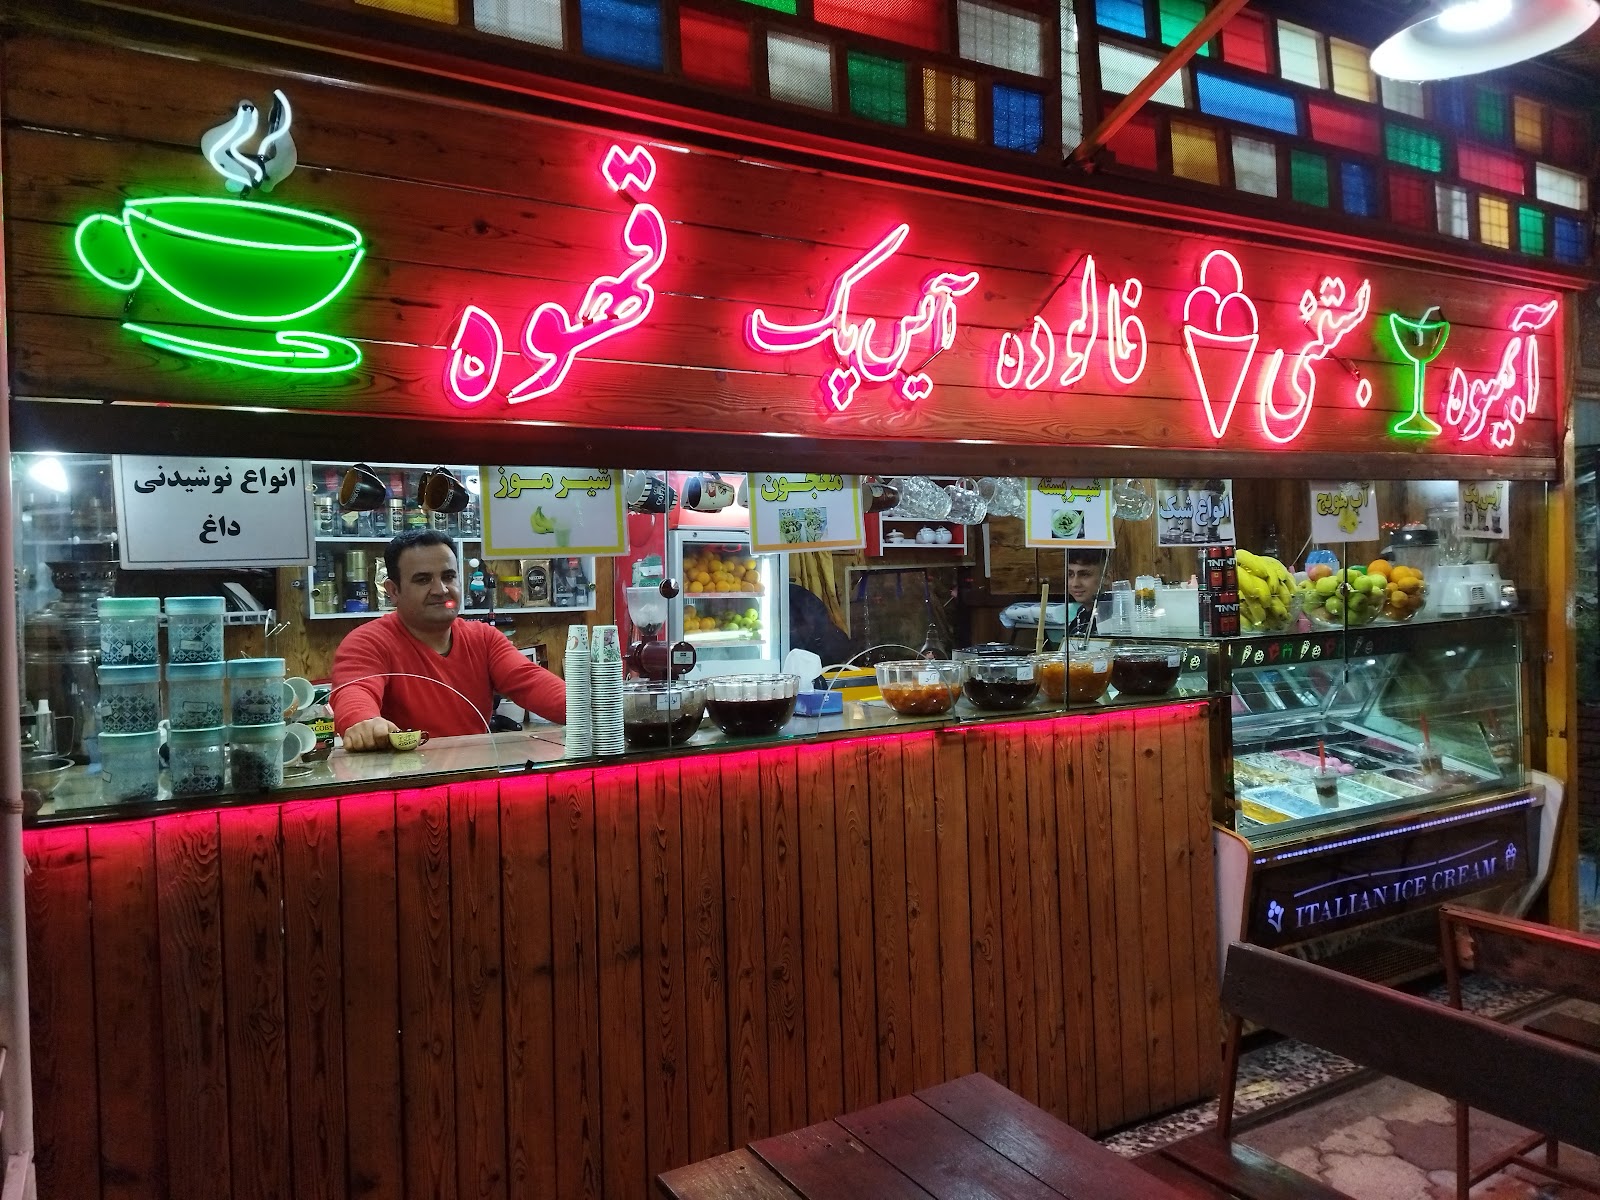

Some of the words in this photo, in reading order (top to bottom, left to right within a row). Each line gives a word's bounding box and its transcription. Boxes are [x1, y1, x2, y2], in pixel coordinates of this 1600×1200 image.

[449, 144, 668, 405] قهوه
[996, 254, 1148, 390] فالوده
[1260, 276, 1373, 443] بستنی
[1446, 300, 1558, 449] آبمیوه
[134, 465, 233, 494] نوشیدنی
[240, 466, 296, 494] انواع
[494, 466, 553, 498] موز
[555, 466, 612, 498] شیر
[761, 473, 844, 501] معجون
[1159, 495, 1194, 525] شیک
[1195, 494, 1230, 526] انواع
[1317, 491, 1349, 515] هویج
[1350, 483, 1370, 515] آب
[199, 514, 241, 543] داغ
[1207, 559, 1226, 567] TNT
[1296, 886, 1388, 929] ITALIAN
[1393, 876, 1427, 903] ICE
[1432, 857, 1497, 892] CREAM
